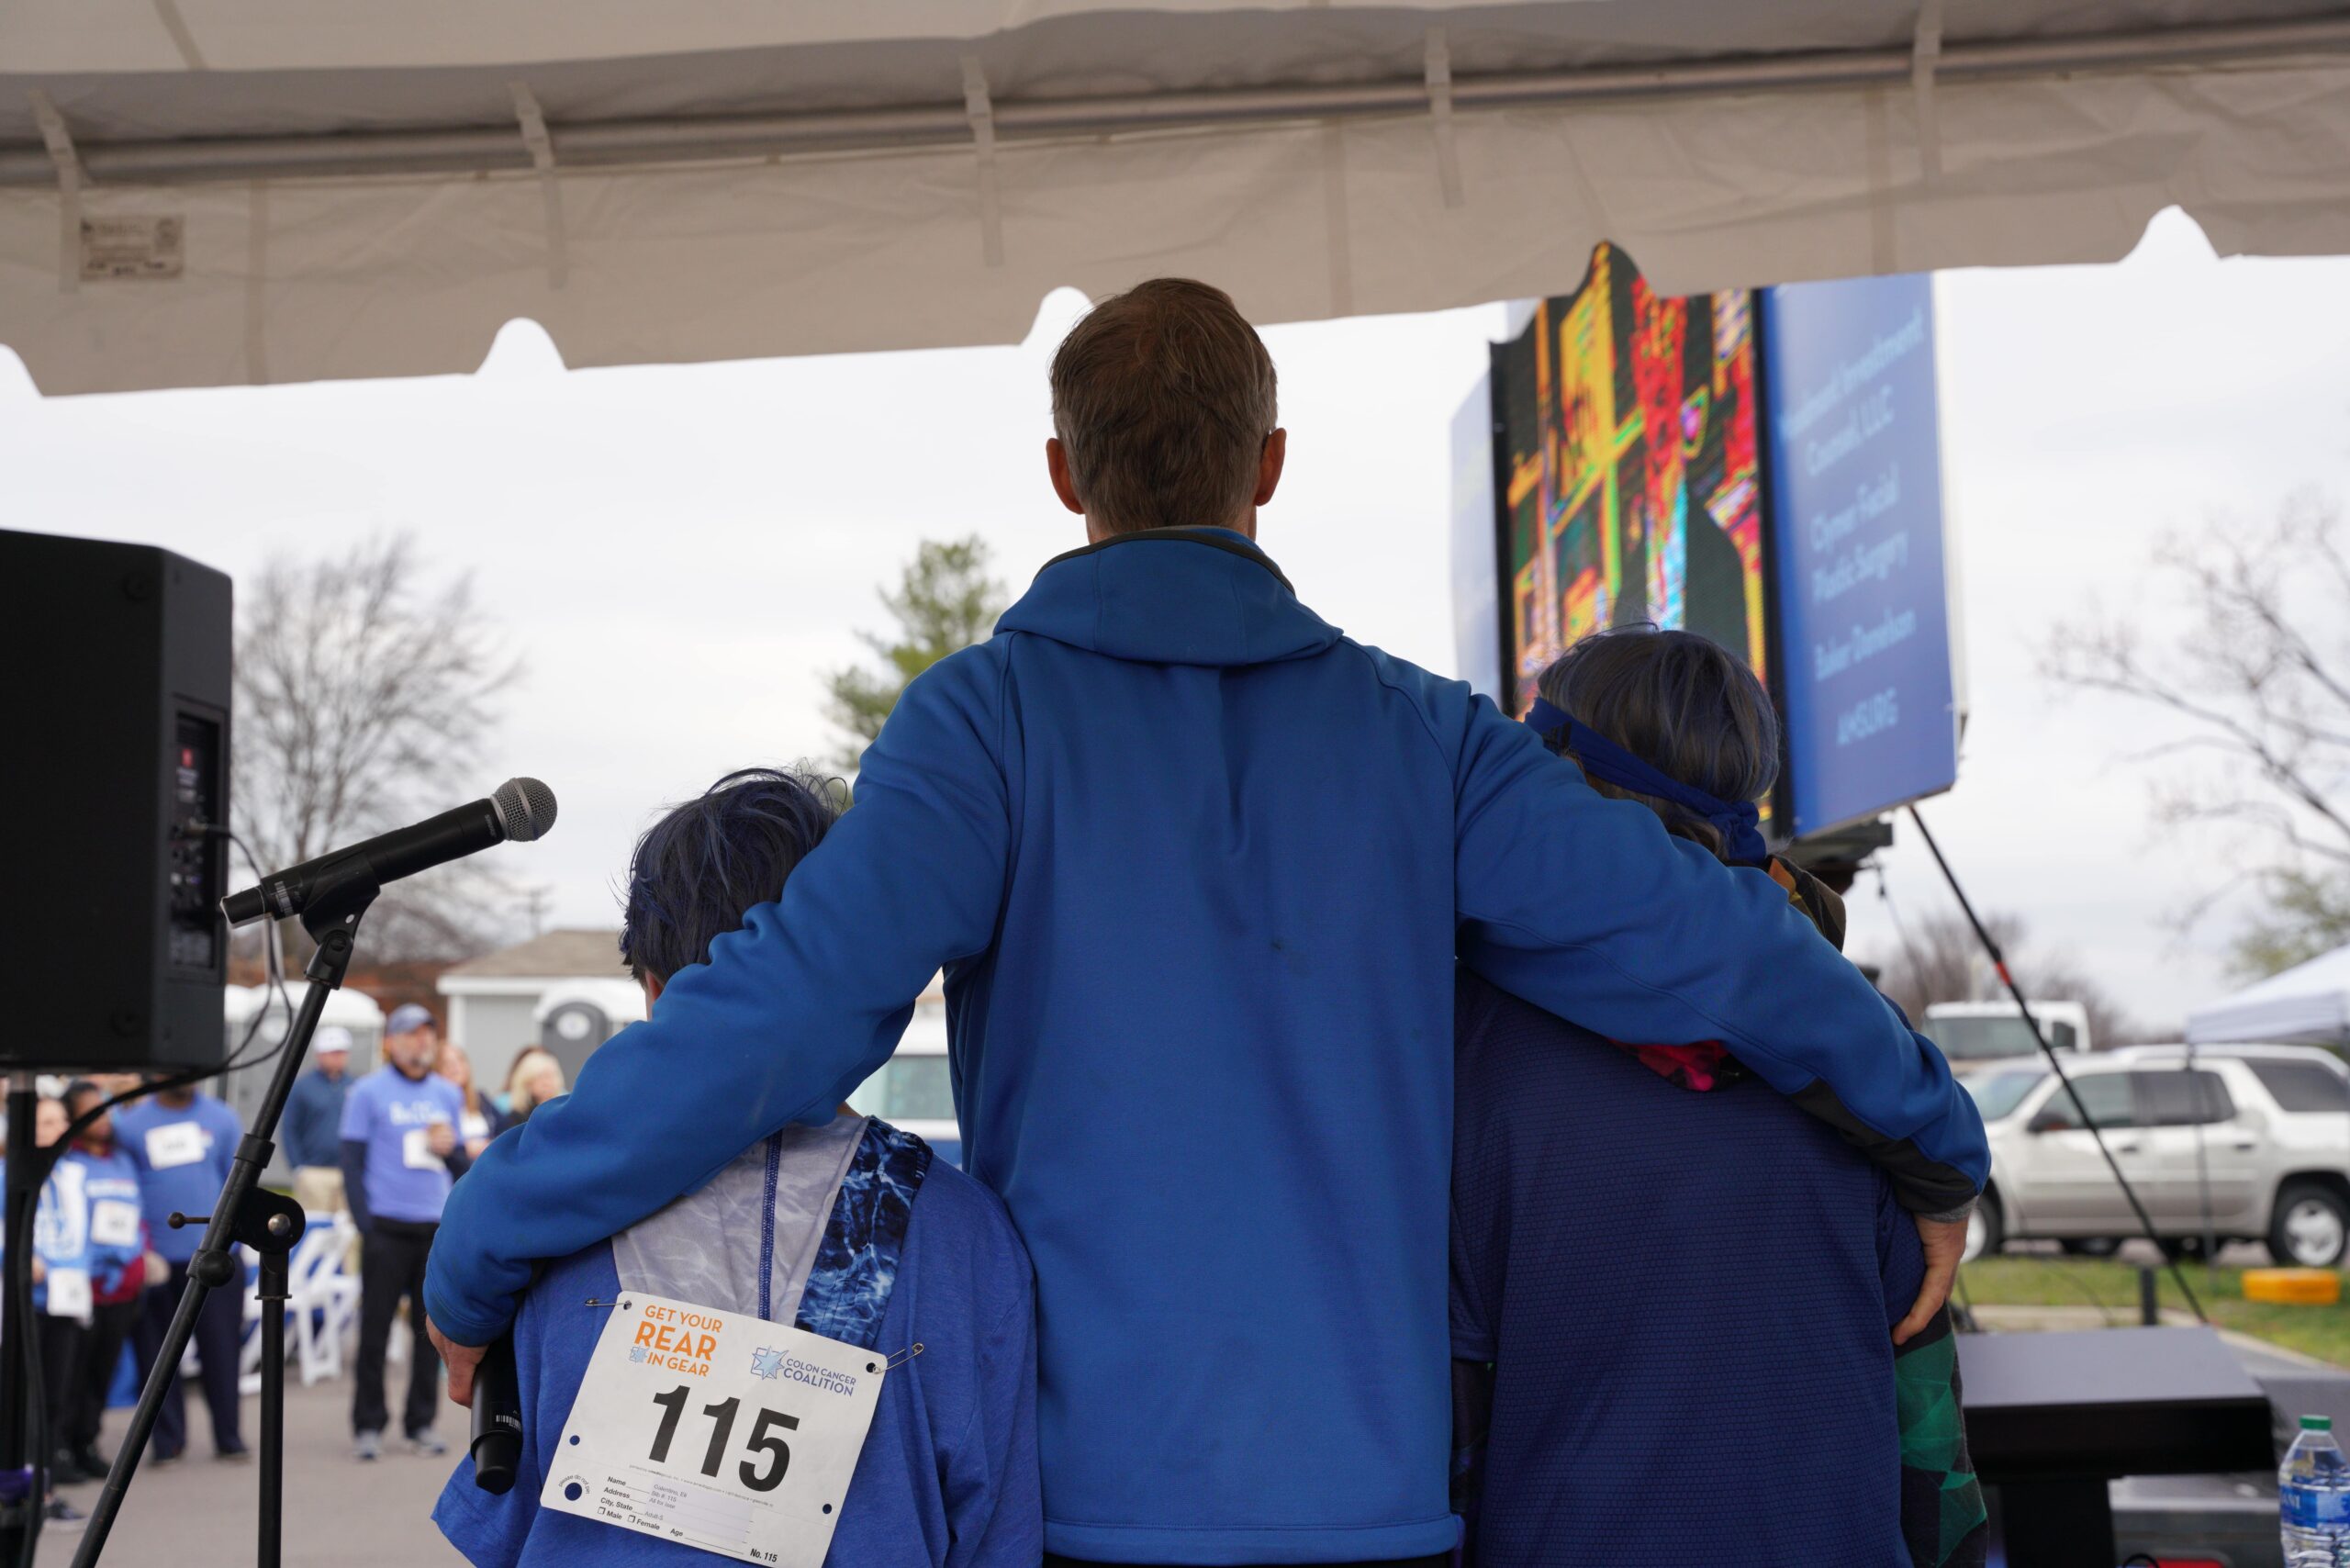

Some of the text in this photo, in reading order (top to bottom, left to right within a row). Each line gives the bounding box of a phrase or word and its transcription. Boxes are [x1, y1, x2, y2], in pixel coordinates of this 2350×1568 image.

[644, 1305, 722, 1333] GET YOUR
[634, 1320, 717, 1361] REAR
[646, 1352, 710, 1377] IN GEAR
[787, 1359, 856, 1385] COLON CANCER
[783, 1368, 854, 1397] COALITION
[648, 1384, 800, 1493] 115
[603, 1486, 631, 1499] Address
[607, 1476, 626, 1485] Name
[600, 1497, 633, 1511] City, State
[606, 1510, 684, 1538] Male Female Age
[750, 1548, 778, 1562] No. 115
